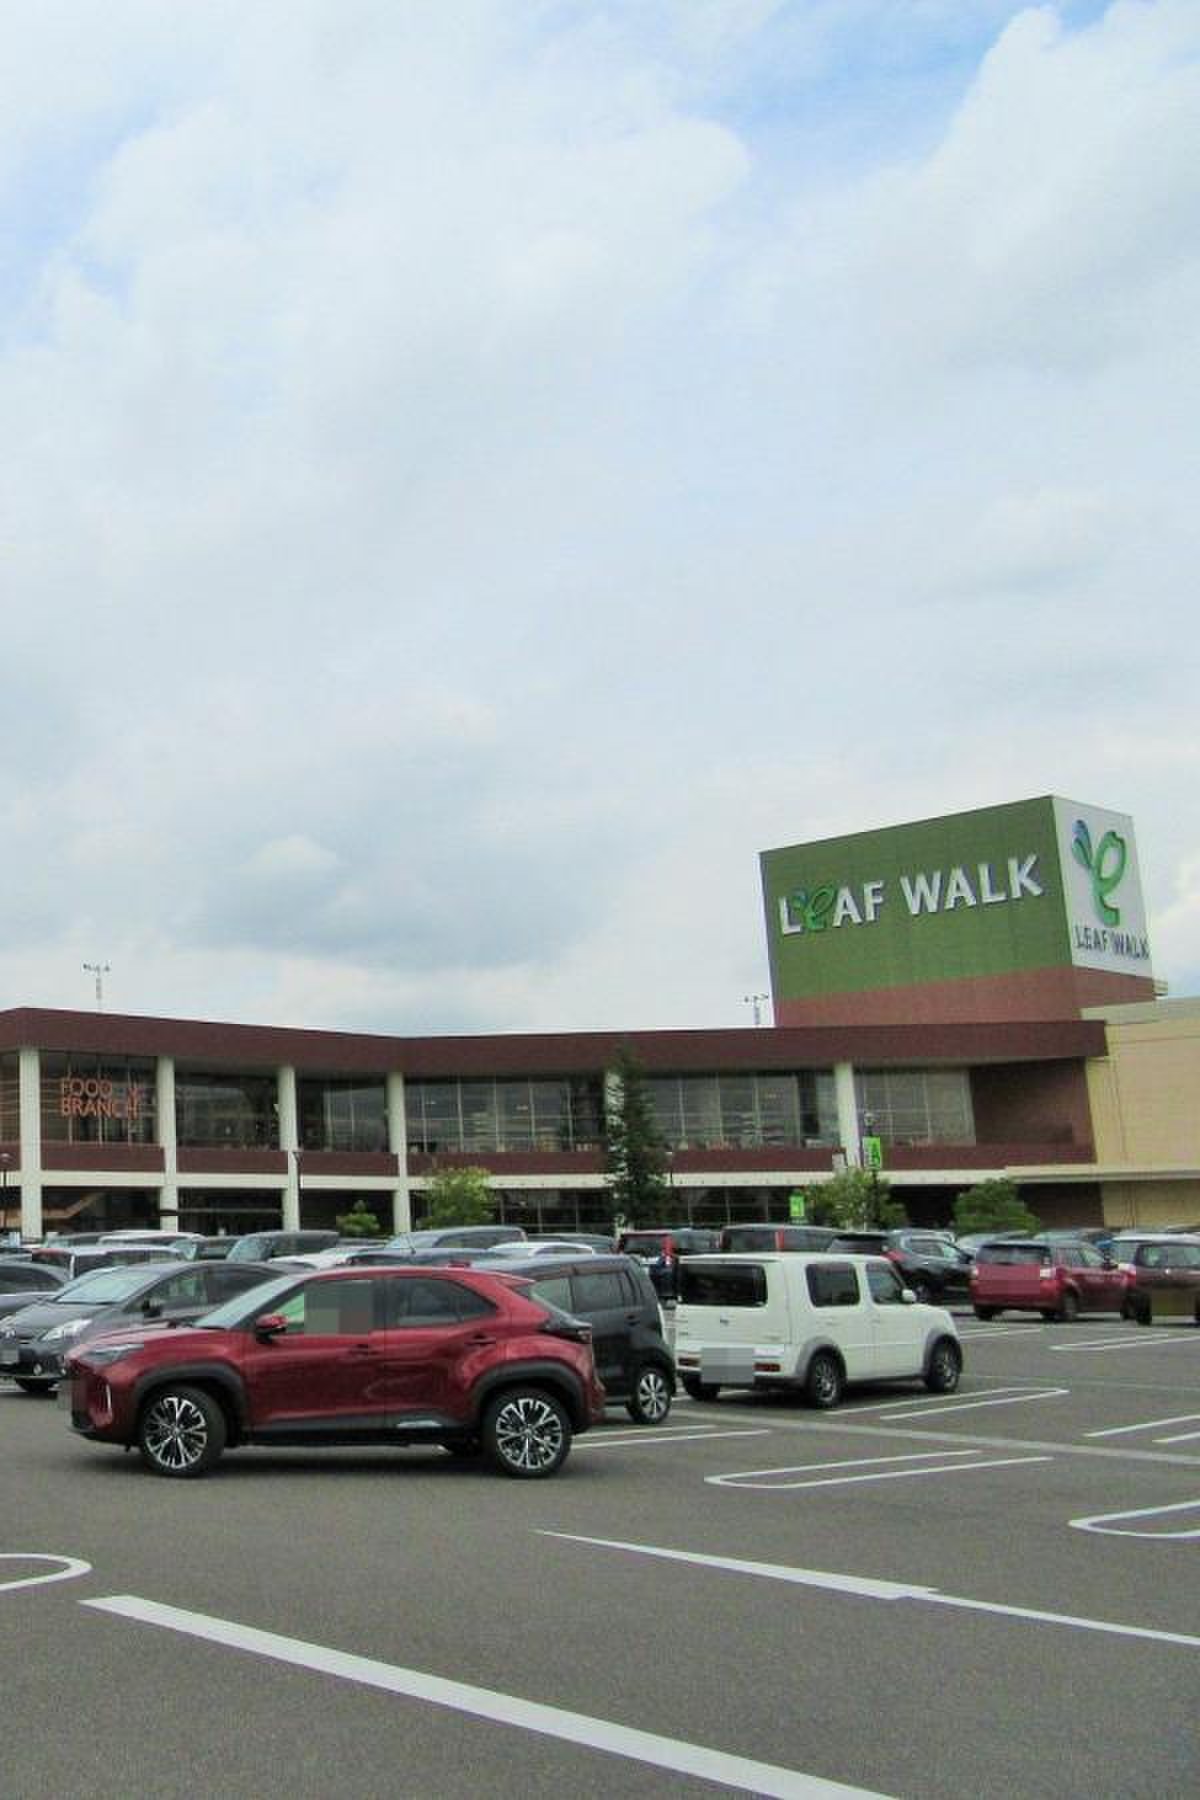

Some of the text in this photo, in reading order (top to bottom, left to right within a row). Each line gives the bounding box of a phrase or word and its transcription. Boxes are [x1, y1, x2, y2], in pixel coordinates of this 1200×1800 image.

[900, 854, 1043, 916] WALK
[1075, 925, 1150, 960] LEAF WALK
[61, 1077, 113, 1099] FOOD
